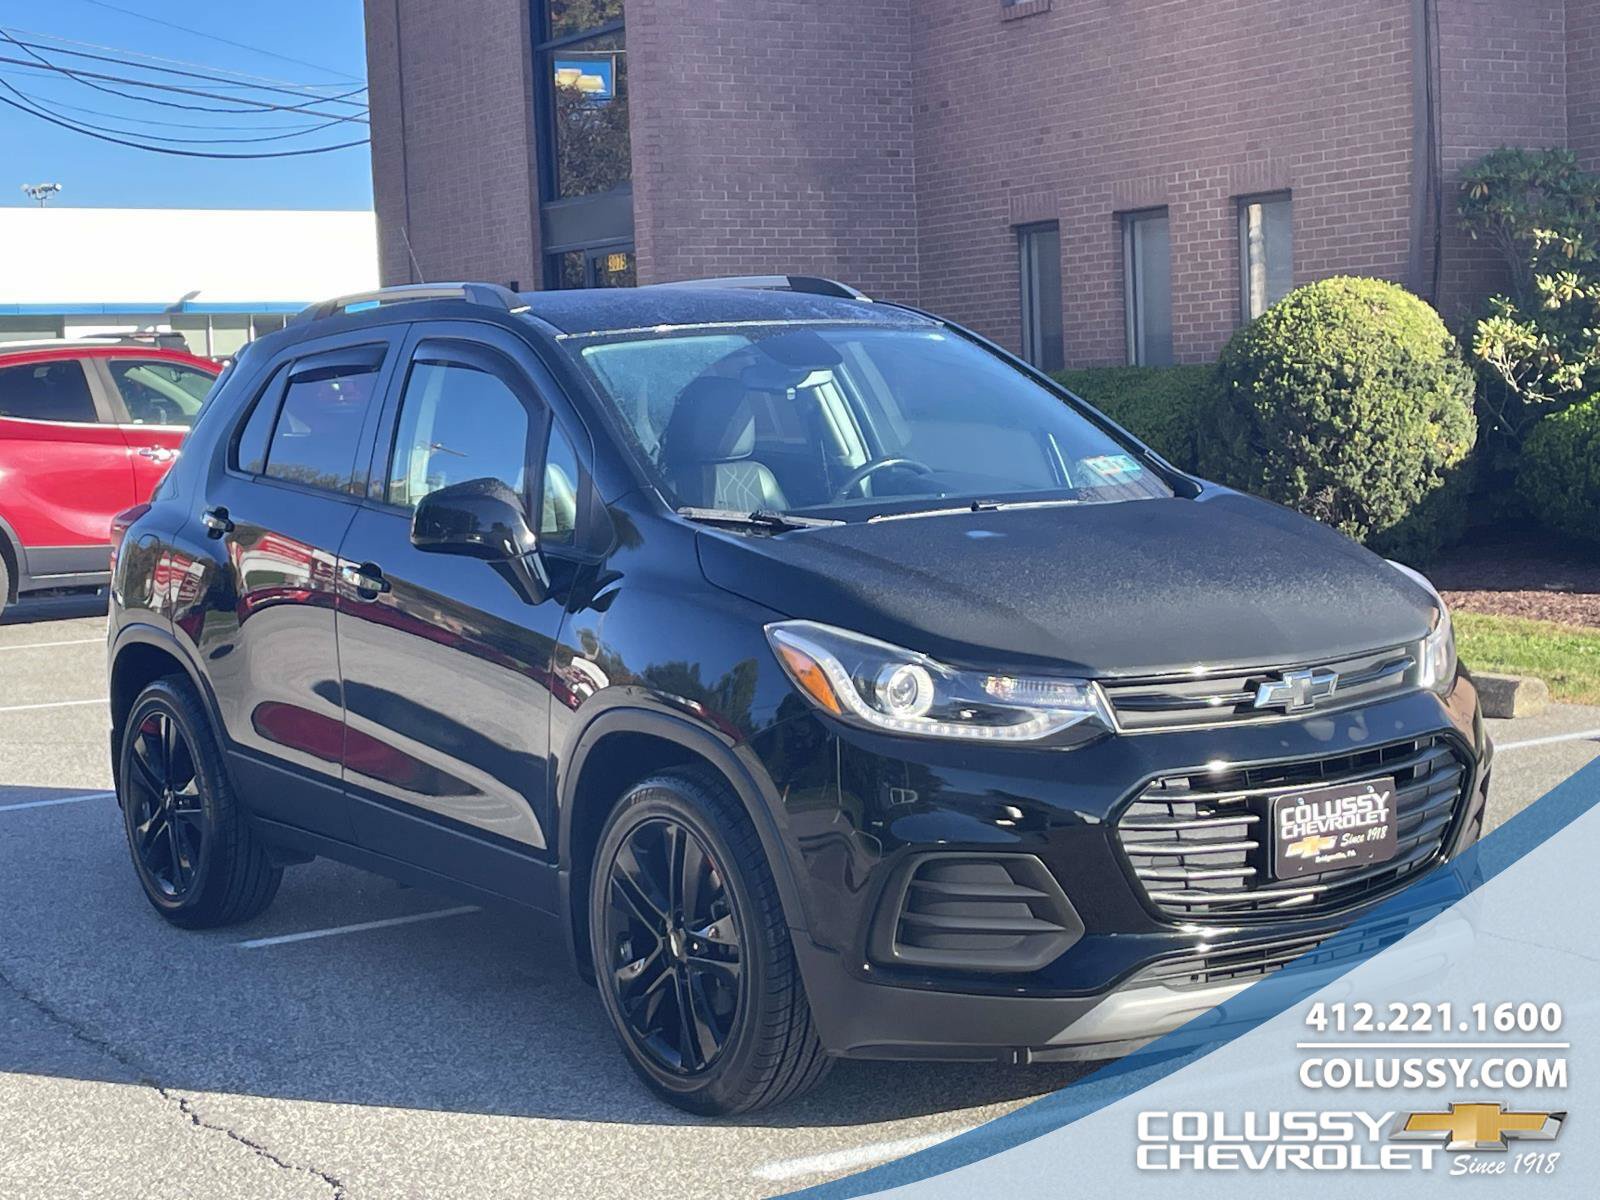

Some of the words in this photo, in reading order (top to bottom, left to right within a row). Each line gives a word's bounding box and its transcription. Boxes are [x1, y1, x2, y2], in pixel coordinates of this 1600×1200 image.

[1280, 791, 1390, 826] COLUSSY
[1281, 808, 1390, 840] CHEVROLET
[1340, 832, 1364, 847] Since
[1366, 825, 1388, 841] 1918
